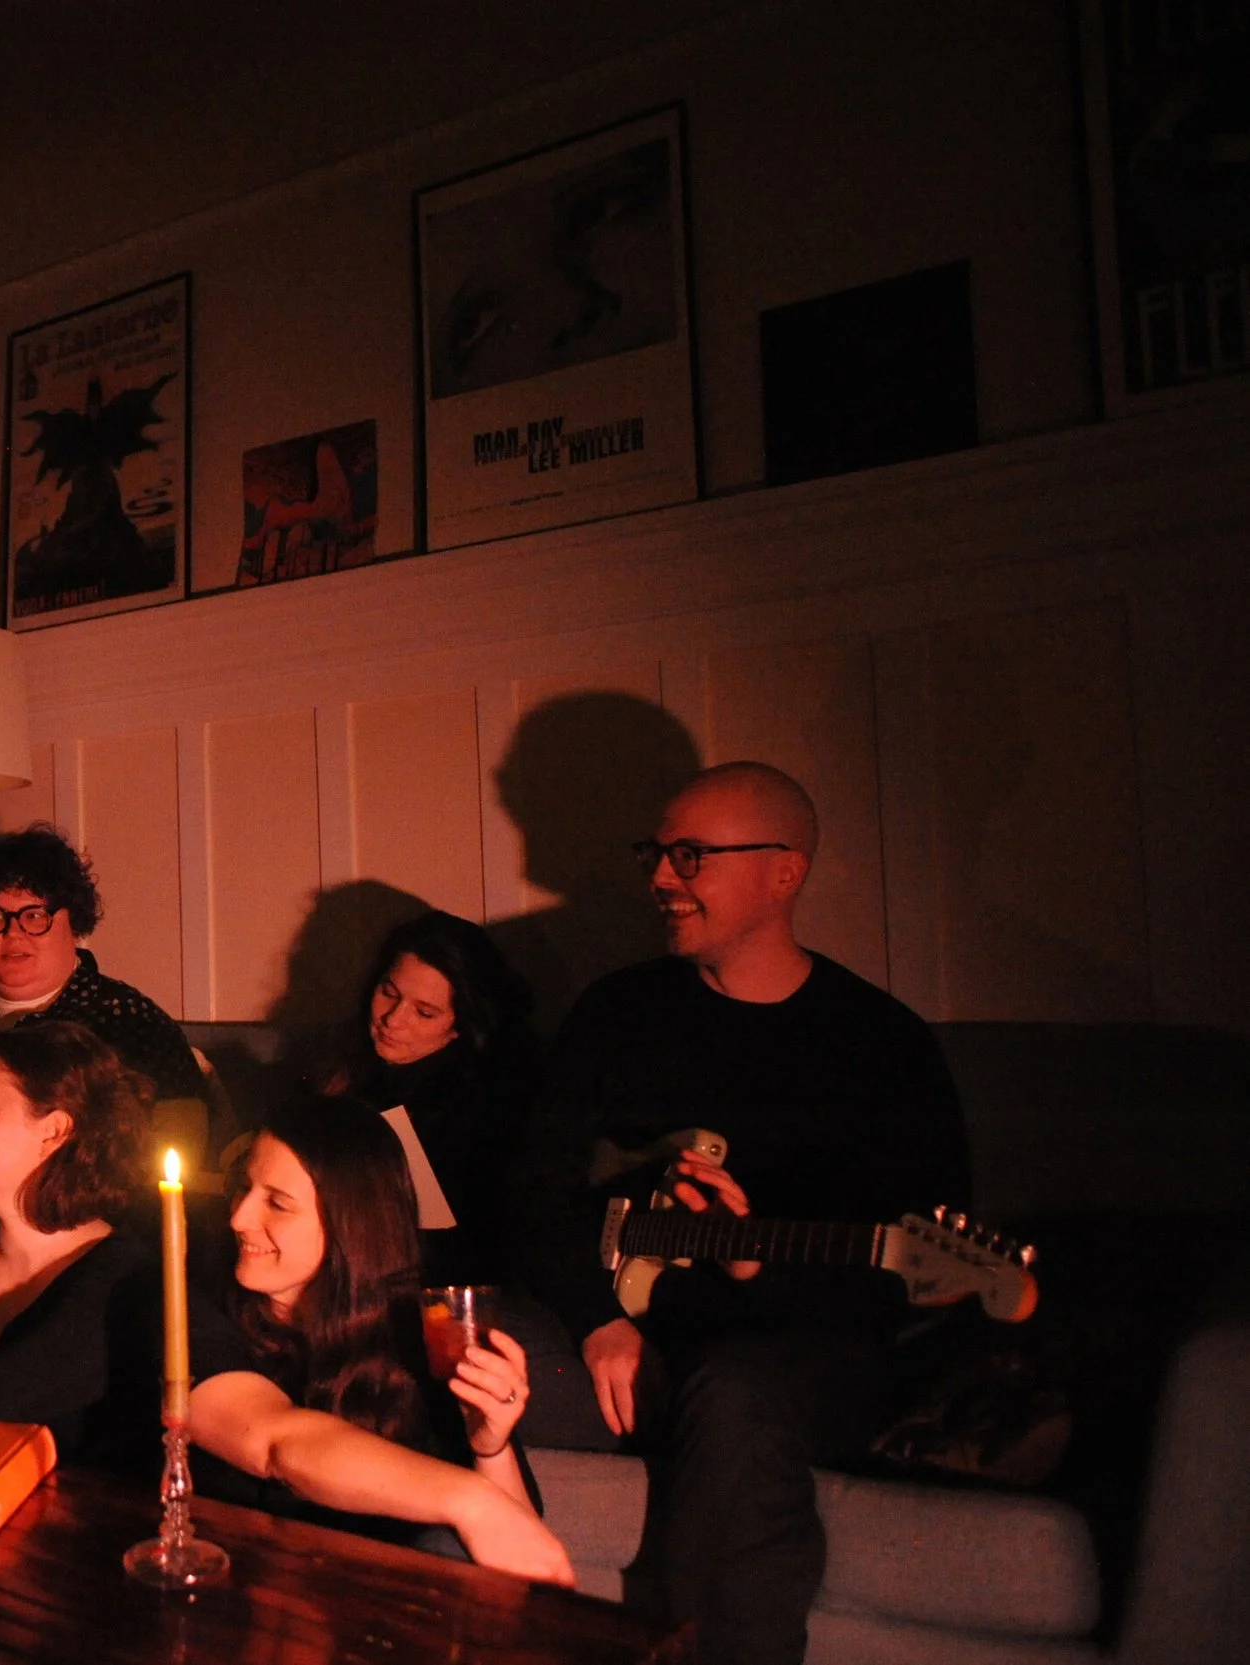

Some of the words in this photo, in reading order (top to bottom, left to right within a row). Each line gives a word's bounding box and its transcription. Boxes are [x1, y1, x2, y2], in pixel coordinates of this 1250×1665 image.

[473, 427, 518, 455] MAN
[527, 416, 563, 443] RAY
[528, 447, 562, 473] LEE
[569, 431, 643, 465] MILLER
